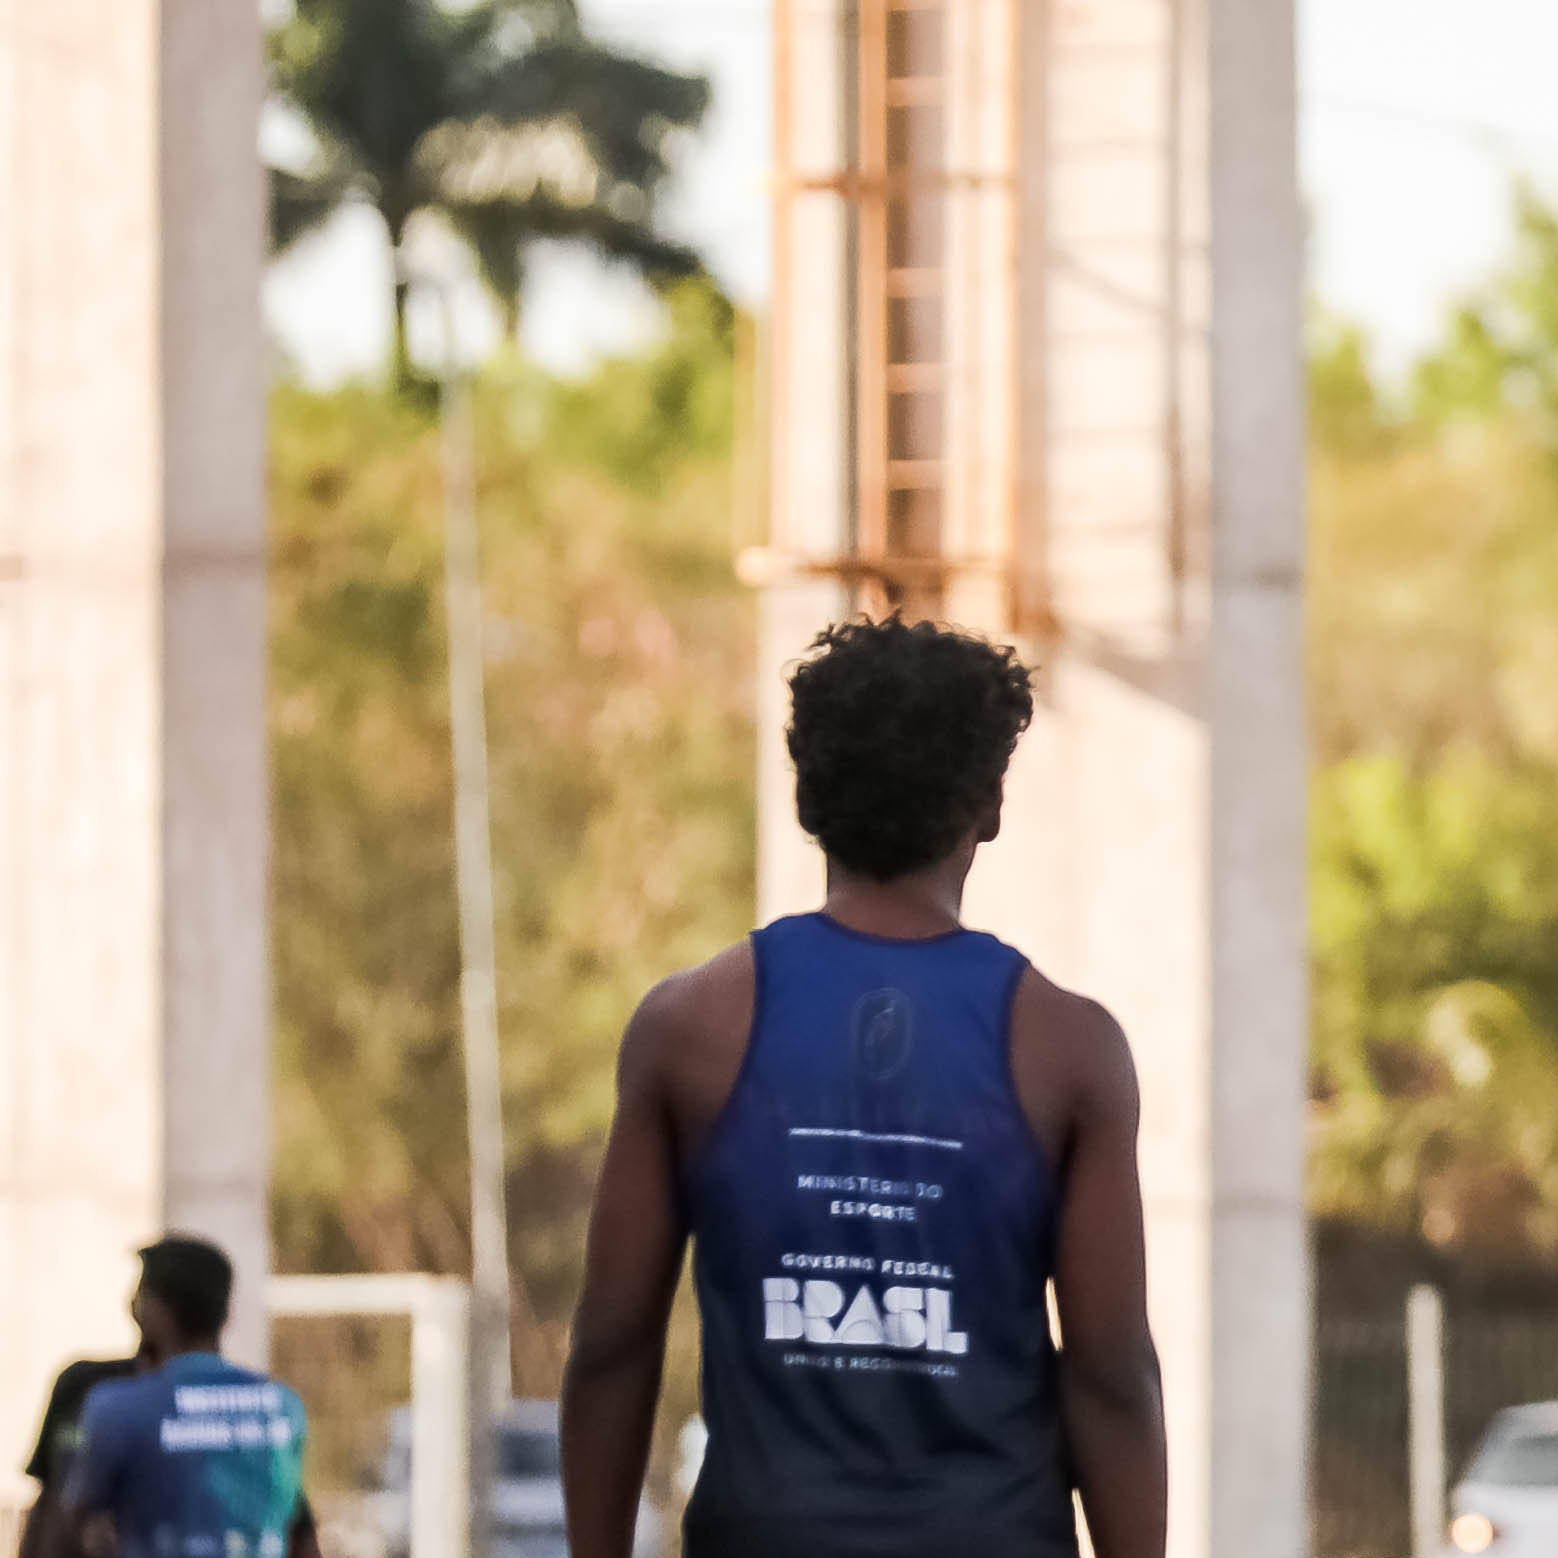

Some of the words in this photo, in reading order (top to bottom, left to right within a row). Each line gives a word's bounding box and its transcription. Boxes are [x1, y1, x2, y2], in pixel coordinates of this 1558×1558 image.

[830, 1200, 916, 1221] ESPORTE
[781, 1253, 875, 1270] GOVERNO
[881, 1259, 954, 1279] FEDERAL
[762, 1277, 968, 1354] BRASIL
